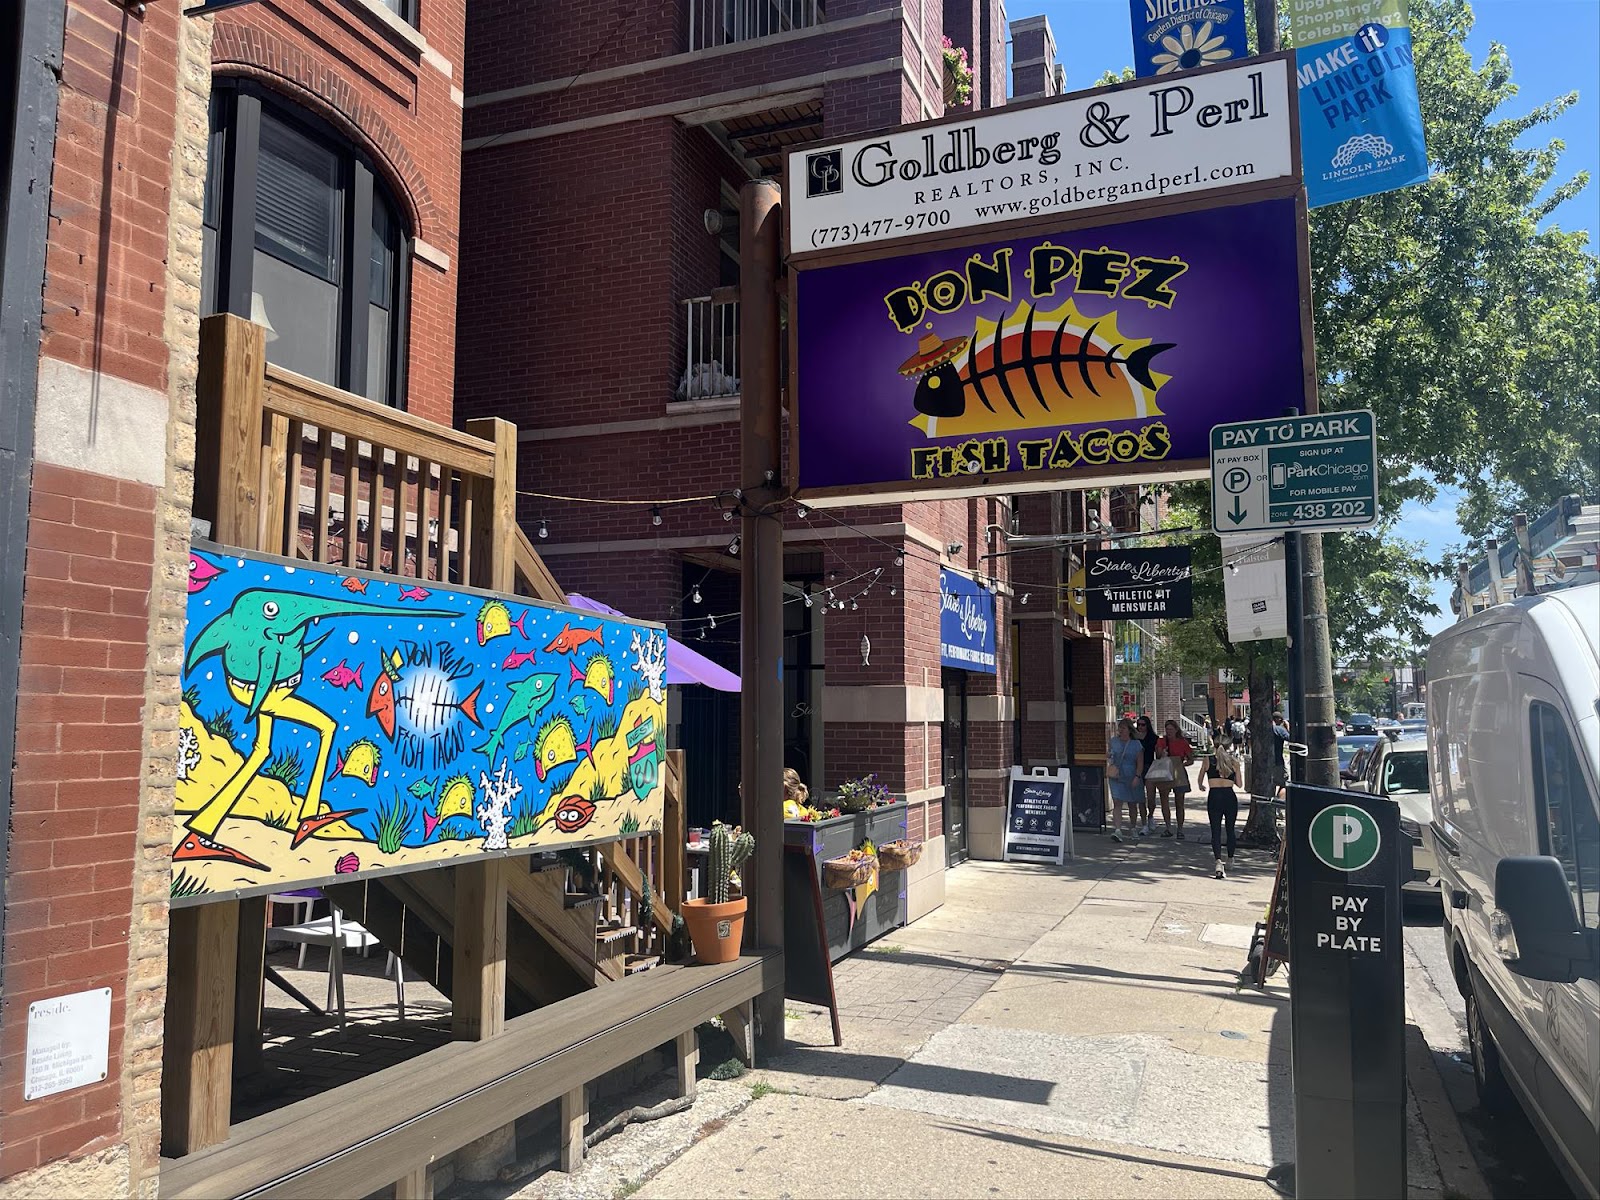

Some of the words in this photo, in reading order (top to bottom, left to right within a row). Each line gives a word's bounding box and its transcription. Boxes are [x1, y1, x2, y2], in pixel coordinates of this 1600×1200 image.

[1147, 21, 1171, 43] Garden
[1170, 11, 1195, 27] District
[1195, 9, 1203, 20] of
[1202, 9, 1228, 24] Chicago
[1297, 0, 1382, 27] Shopping?
[1296, 42, 1359, 89] MAKE
[1359, 26, 1385, 53] it
[1312, 44, 1413, 106] LINCOLN
[1323, 79, 1394, 129] PARK
[852, 126, 1062, 188] Goldberg
[1079, 101, 1130, 148] &
[1149, 72, 1269, 138] Perl
[914, 169, 1059, 205] REALTORS,
[1074, 157, 1129, 178] INC.
[1322, 162, 1373, 181] LINCOLN
[1377, 154, 1406, 168] PARK
[811, 209, 951, 248] (773)477-9700
[975, 162, 1255, 218] www.goldbergandperl.com
[884, 248, 1013, 333] DON
[1024, 241, 1189, 309] PEZ
[1222, 427, 1260, 446] PAY
[1265, 424, 1294, 442] TO
[1301, 417, 1360, 439] PARK
[911, 437, 1010, 479] FISH
[1018, 421, 1172, 469] TACOS
[1216, 457, 1227, 465] AT
[1227, 456, 1241, 464] PAY
[1243, 454, 1260, 462] BOX
[1299, 448, 1320, 457] SIGN
[1321, 448, 1333, 456] UP
[1333, 446, 1344, 454] AT
[1256, 474, 1268, 482] OR
[1287, 463, 1369, 479] ParkChicago
[1289, 489, 1306, 497] FOR
[1308, 487, 1340, 495] MOBILE
[1341, 485, 1357, 493] PAY
[1271, 510, 1289, 518] ZONE
[1293, 503, 1326, 519] 438
[1331, 501, 1366, 517] 202
[1090, 557, 1132, 576] State
[1132, 561, 1184, 582] Liberty
[1106, 589, 1153, 601] ATHLETIC
[1112, 601, 1166, 613] MENSWEAR
[399, 639, 432, 668] DON
[430, 721, 465, 771] TACOS
[634, 758, 655, 789] 80
[1331, 895, 1369, 912] PAY
[1336, 916, 1363, 932] BY
[1317, 932, 1381, 953] PLATE
